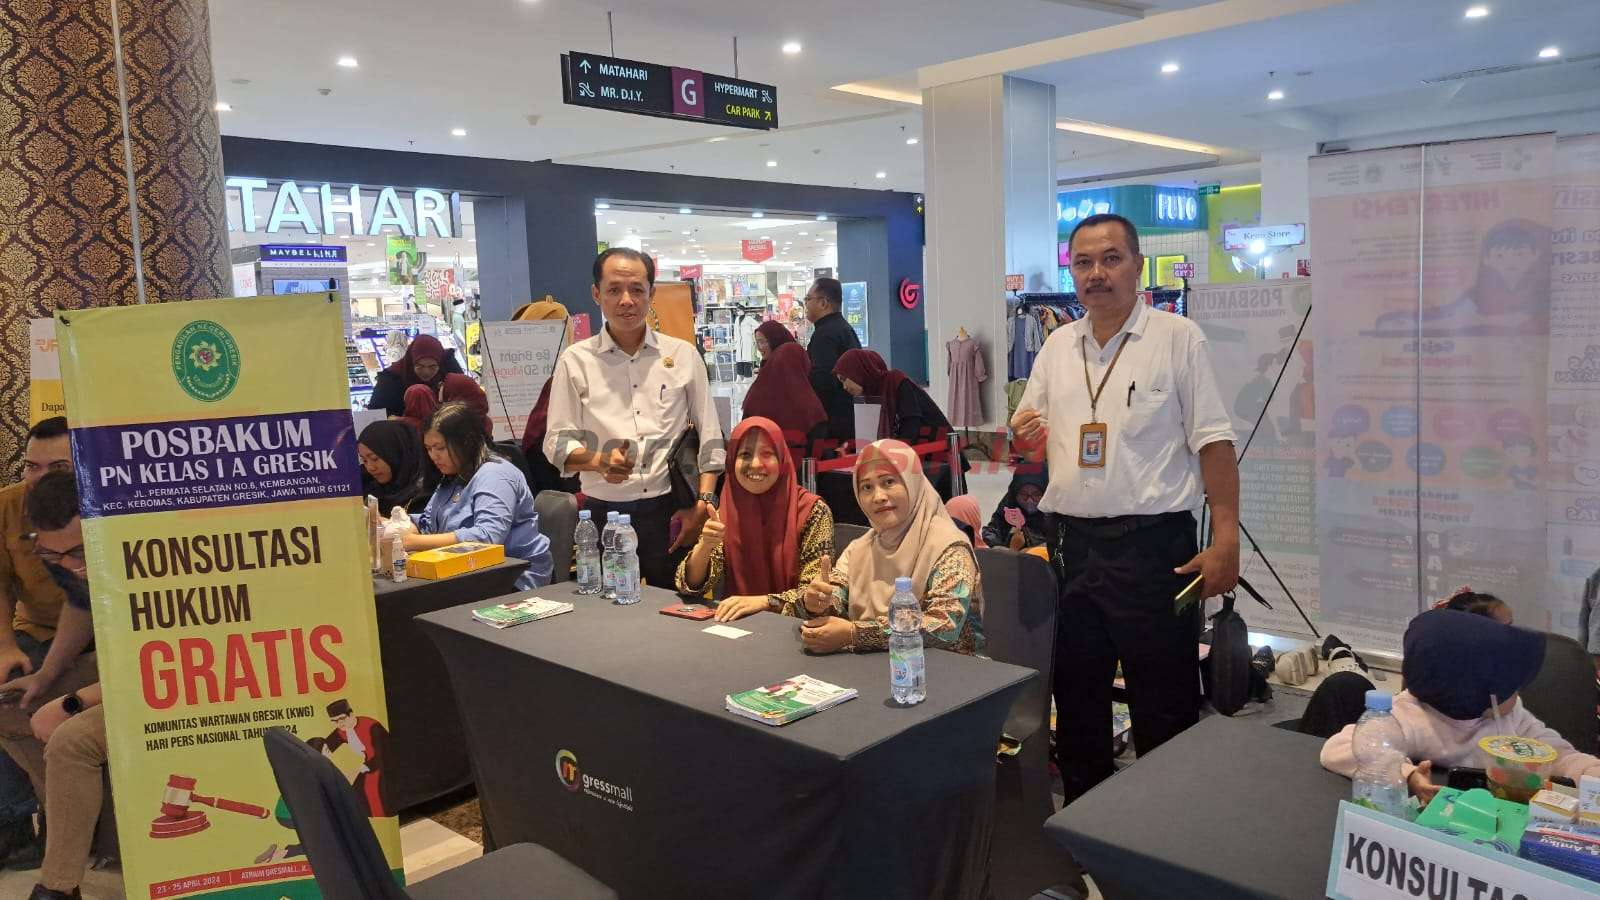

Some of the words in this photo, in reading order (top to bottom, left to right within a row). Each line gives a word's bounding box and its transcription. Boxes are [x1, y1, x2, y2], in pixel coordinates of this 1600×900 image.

[599, 63, 648, 81] MATAHARI
[601, 86, 619, 98] MR.
[622, 89, 644, 102] D.I.Y.
[681, 79, 697, 106] G
[714, 82, 758, 98] HYPERMART
[725, 104, 741, 117] CAR
[742, 106, 761, 119] PARK
[226, 178, 463, 238] TAHARI
[269, 248, 337, 258] MAYBELLINE
[121, 418, 312, 460] POSBAKUM
[100, 465, 132, 487] PN
[140, 459, 210, 484] KELAS
[216, 461, 225, 479] I
[232, 460, 247, 478] A
[253, 449, 338, 476] GRESIK
[103, 501, 126, 511] KEC.
[127, 497, 174, 509] KEBOMAS,
[177, 492, 231, 505] KABUPATEN
[232, 490, 269, 502] GRESIK,
[271, 487, 297, 499] JAWA
[298, 484, 326, 496] TIMUR
[327, 483, 351, 494] 61121
[133, 488, 148, 498] JL.
[149, 486, 191, 498] PERMATA
[191, 482, 233, 495] SELATAN
[122, 525, 322, 580] KONSULTASI
[129, 583, 252, 631] HUKUM
[139, 625, 347, 710] GRATIS
[144, 717, 198, 734] KOMUNITAS
[198, 712, 251, 727] WARTAWAN
[252, 707, 284, 722] GRESIK
[285, 705, 314, 720] (KWG)
[146, 737, 169, 751] HARI
[170, 734, 195, 748] PERS
[196, 729, 241, 745] NASIONAL
[582, 773, 633, 801] gressmall
[1345, 832, 1529, 900] KONSULT
[172, 883, 182, 892] 25
[182, 880, 201, 890] APRIL
[202, 876, 221, 886] 2024
